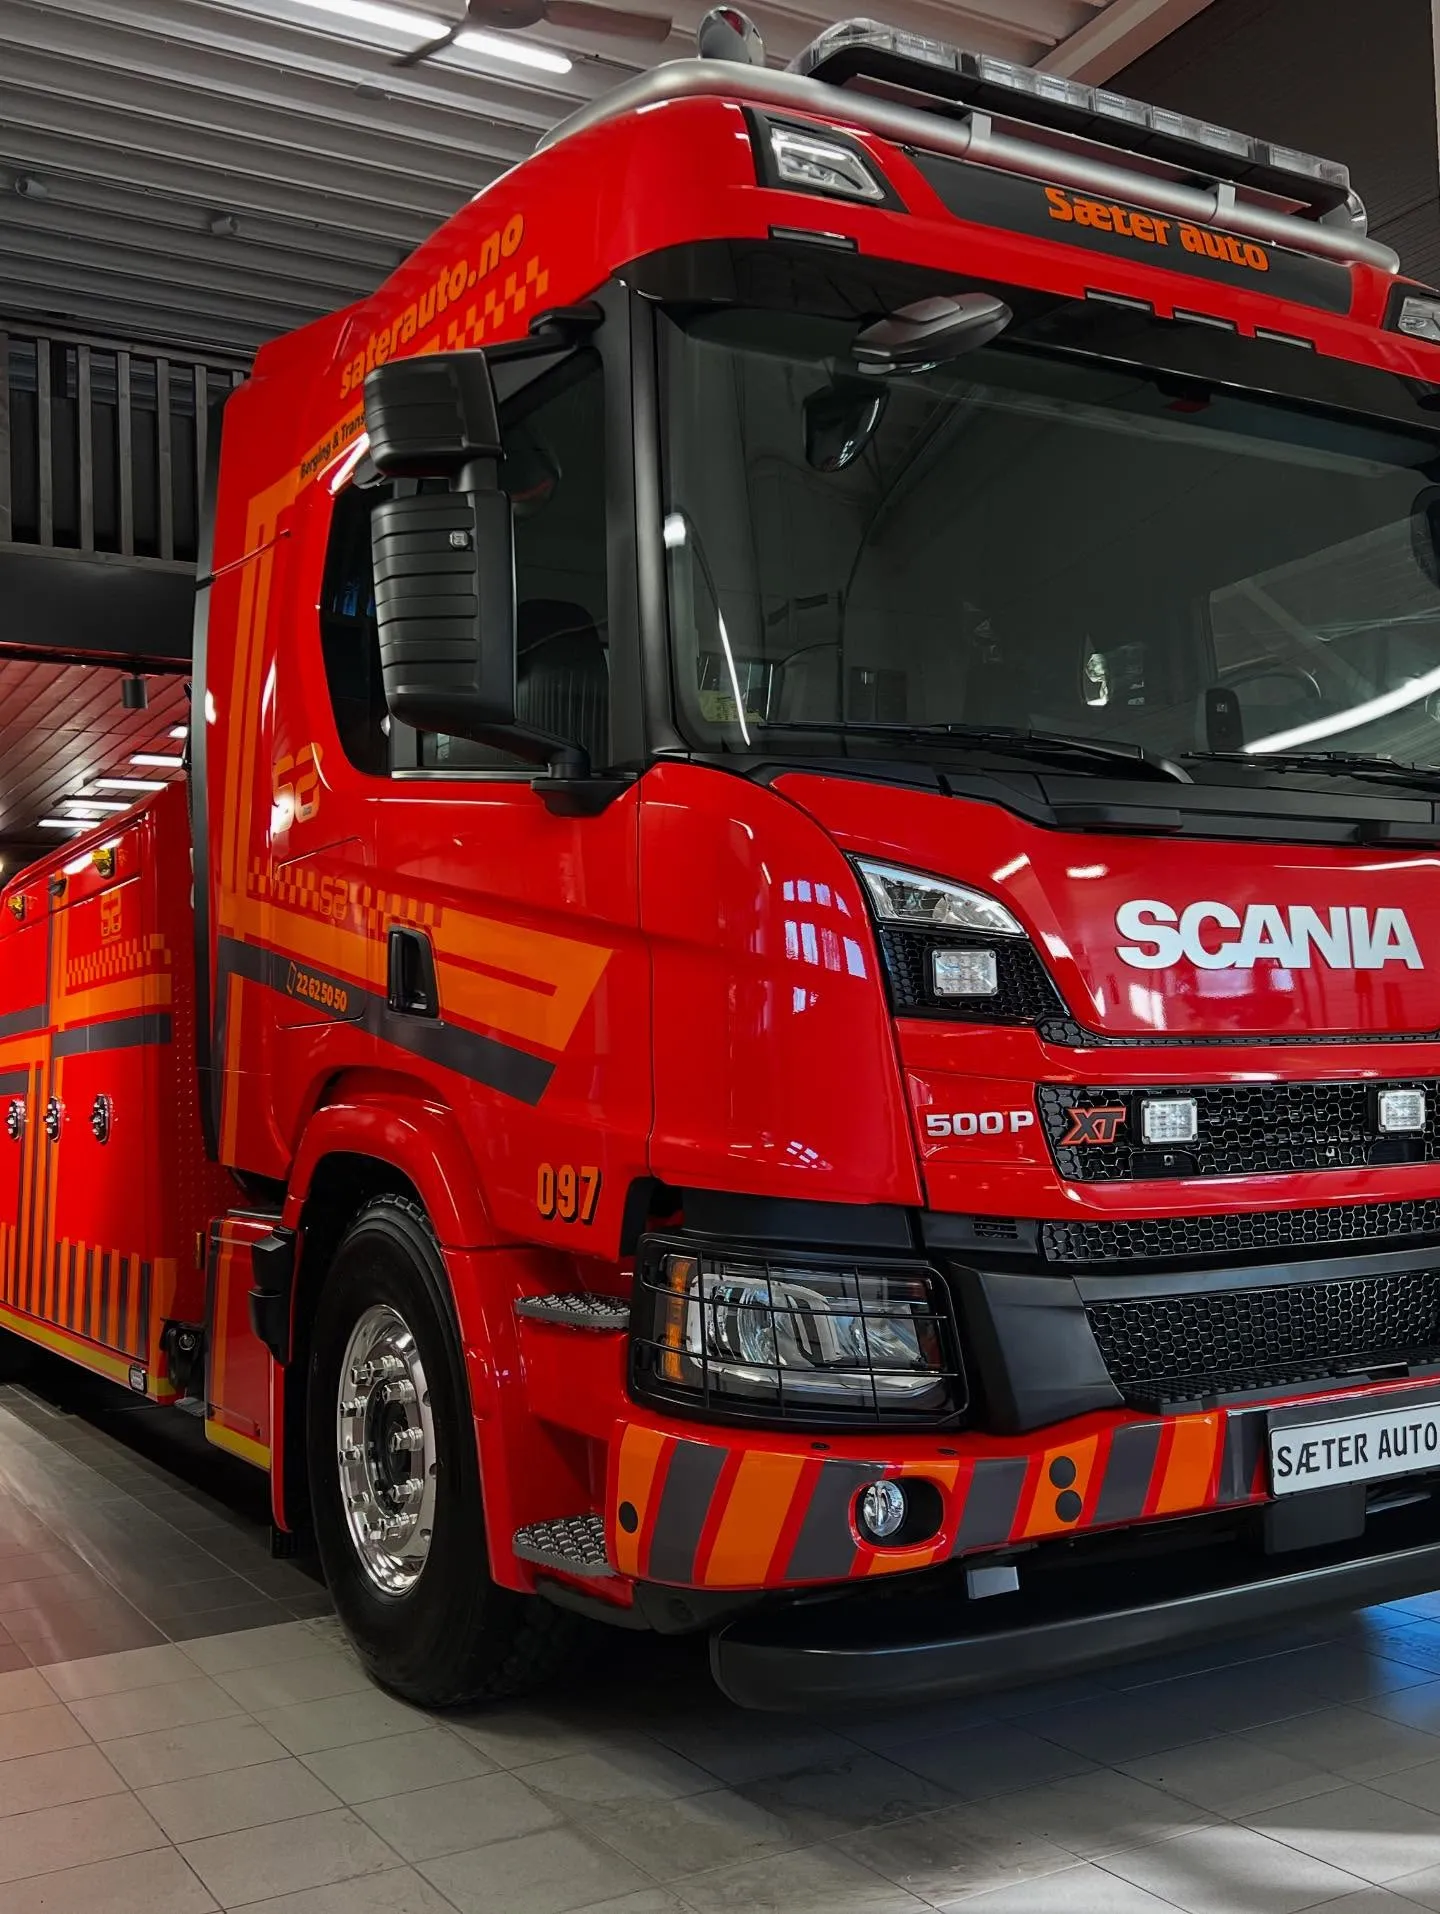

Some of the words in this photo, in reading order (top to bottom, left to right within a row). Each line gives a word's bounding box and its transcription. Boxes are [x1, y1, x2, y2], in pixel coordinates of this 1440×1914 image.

[1043, 186, 1171, 247] Sæter
[1176, 221, 1270, 272] auto
[1114, 899, 1425, 970] SCANIA
[926, 1111, 1004, 1137] 500
[1009, 1110, 1034, 1133] P
[1060, 1107, 1127, 1147] XT
[537, 1162, 602, 1225] 097
[1277, 1432, 1369, 1477] SÆTER
[1378, 1421, 1438, 1460] AUTO
